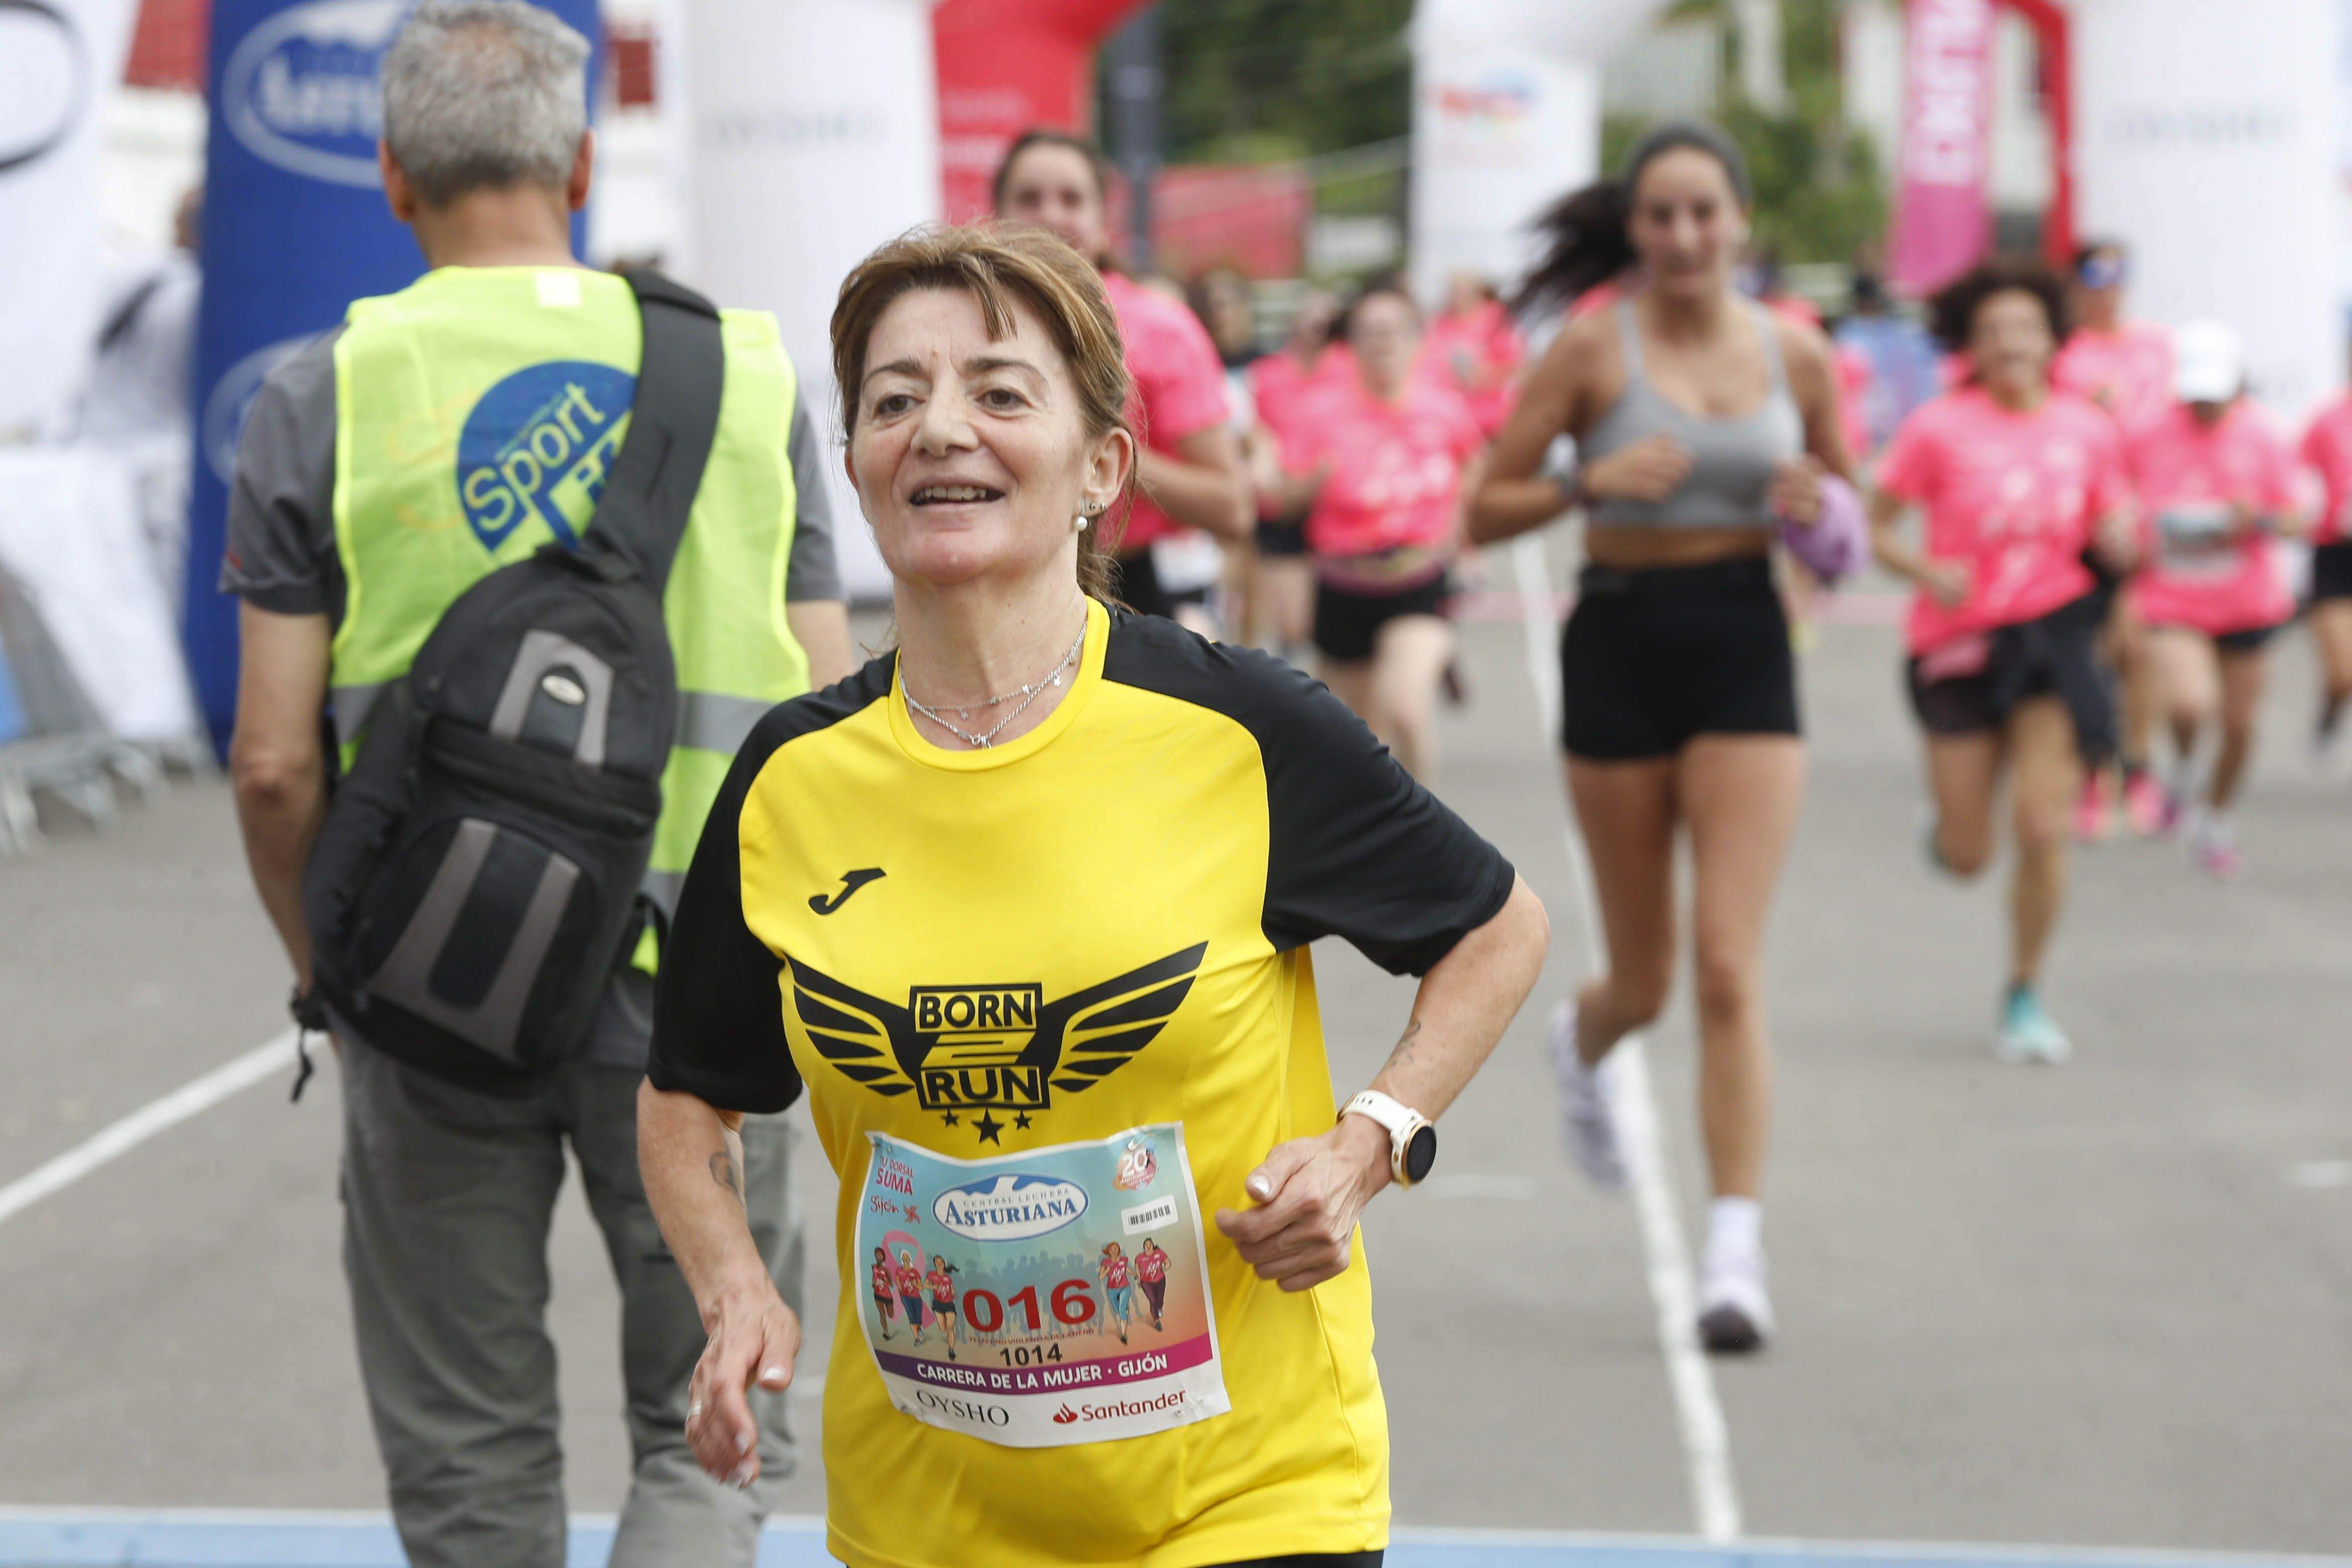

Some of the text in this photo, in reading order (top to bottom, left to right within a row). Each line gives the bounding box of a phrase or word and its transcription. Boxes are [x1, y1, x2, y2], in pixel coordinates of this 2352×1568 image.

[918, 993, 1033, 1029] BORN
[925, 1068, 1039, 1105] RUN
[890, 1159, 913, 1178] DORSAL
[1122, 1149, 1148, 1178] 20
[876, 1167, 913, 1196] SUMA
[945, 1197, 1078, 1227] ASTURIANA
[963, 1187, 1069, 1207] CENTRAL LECHERA
[963, 1278, 1096, 1332] 016
[1000, 1342, 1063, 1366] 1014
[916, 1352, 1168, 1390] CARRERA DE LA MUJER GIJÓN
[916, 1389, 1186, 1427] OYSHO Santander
